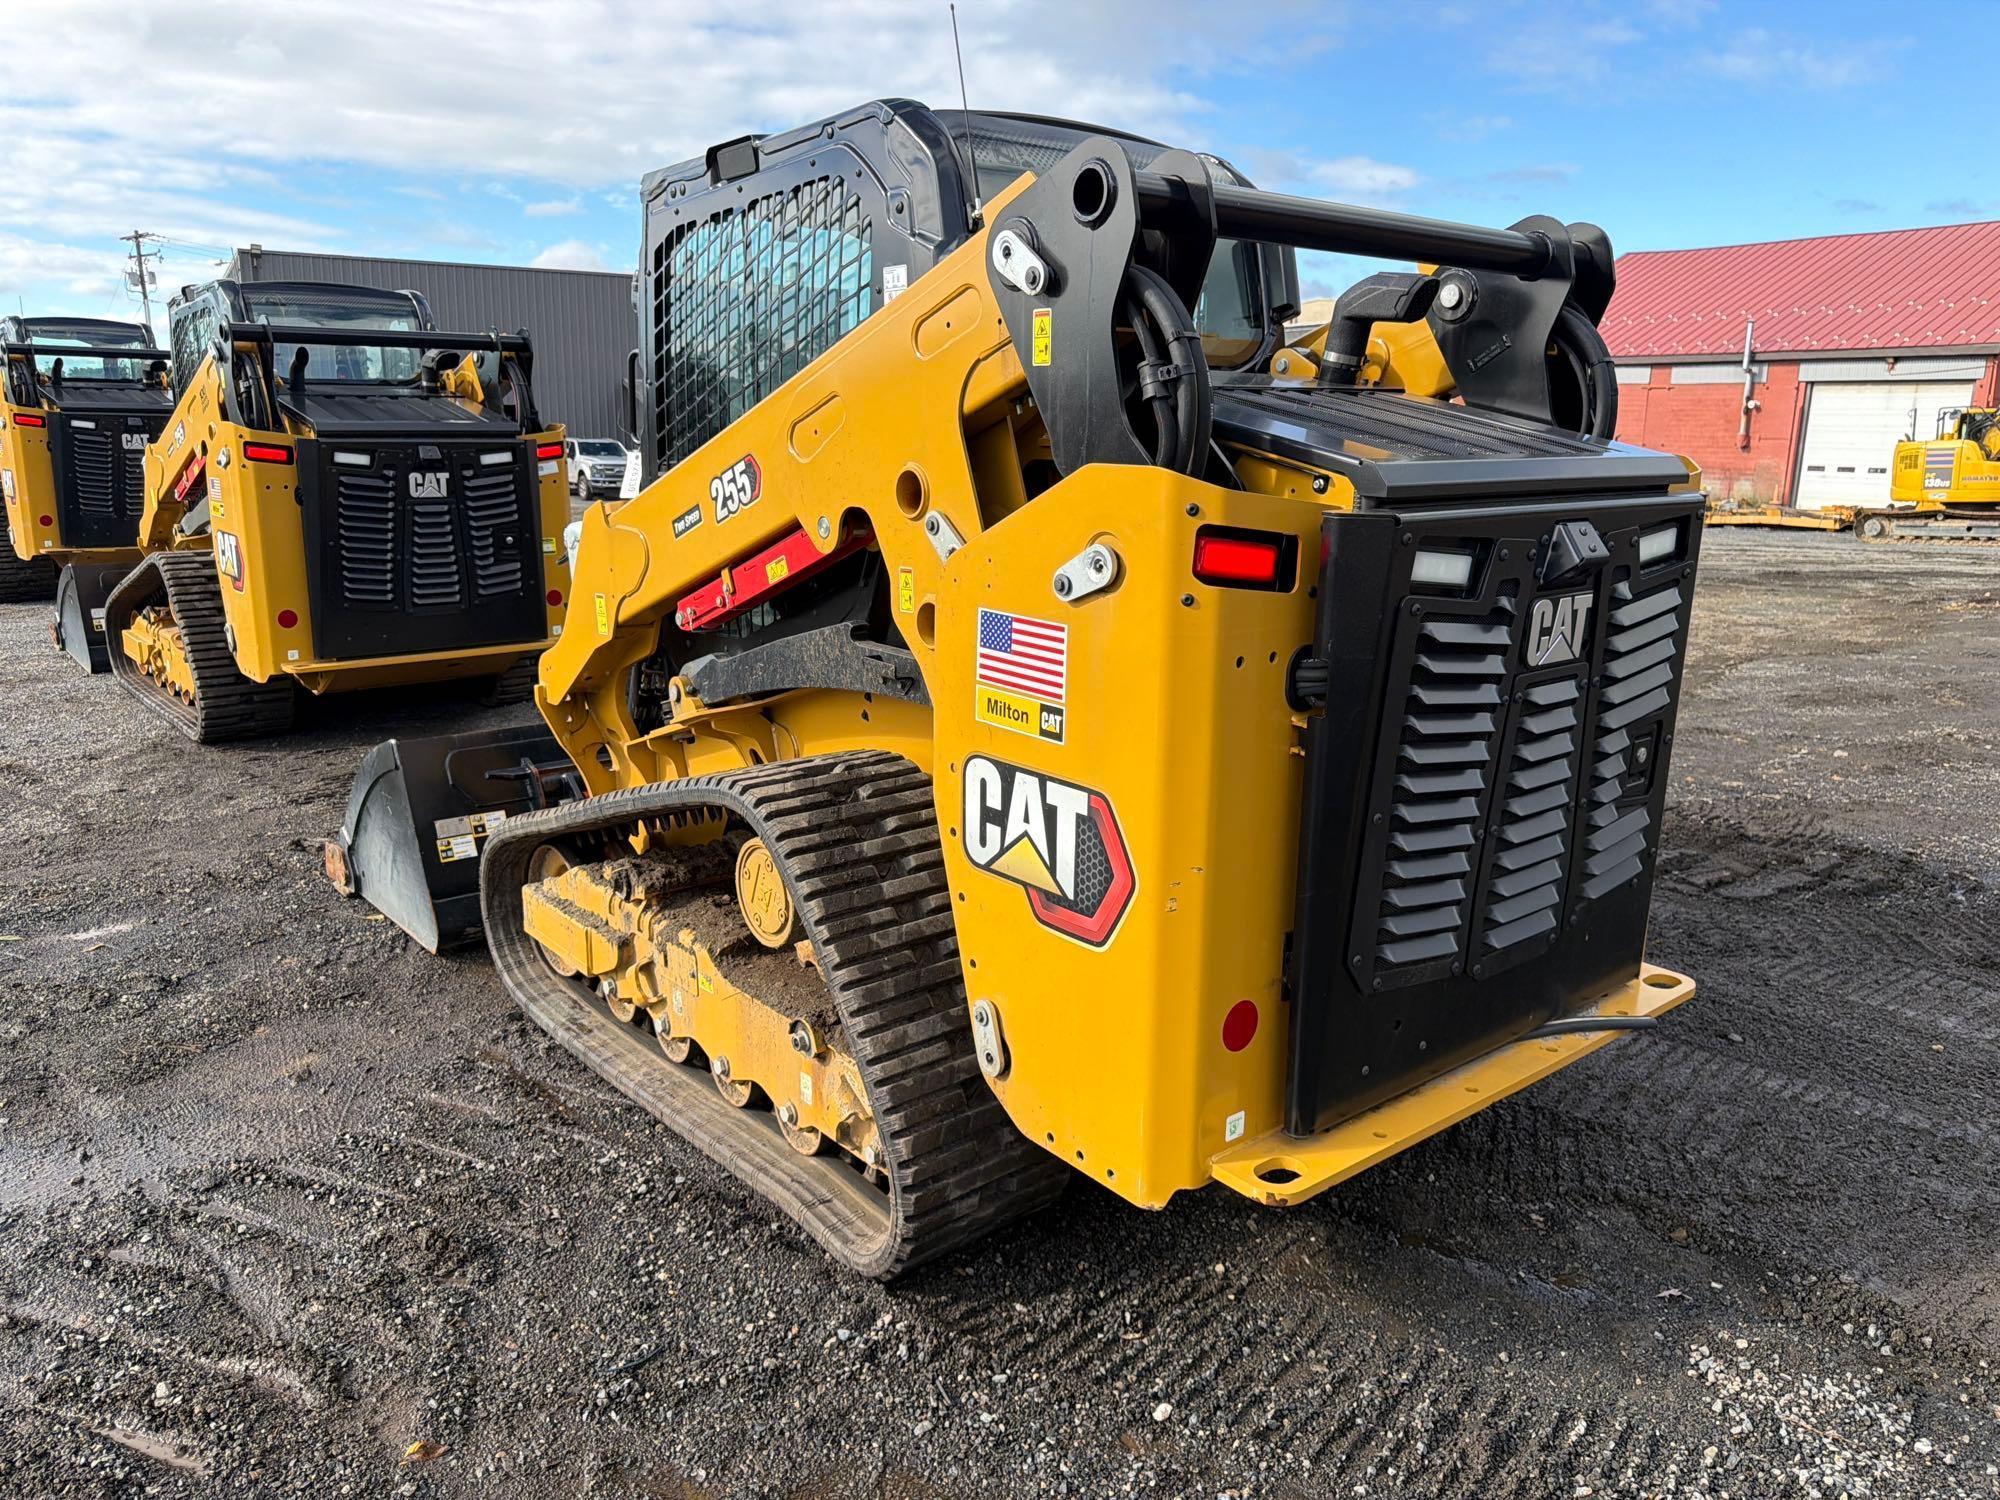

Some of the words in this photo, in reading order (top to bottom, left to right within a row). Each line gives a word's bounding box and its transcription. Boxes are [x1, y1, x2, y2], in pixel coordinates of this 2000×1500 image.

[121, 433, 149, 449] CAT
[409, 472, 449, 498] CAT
[710, 459, 751, 521] 255
[216, 530, 238, 579] CAT
[1526, 594, 1593, 667] CAT
[986, 697, 1029, 724] Milton
[1041, 711, 1062, 734] CAT
[965, 757, 1088, 900] CAT
